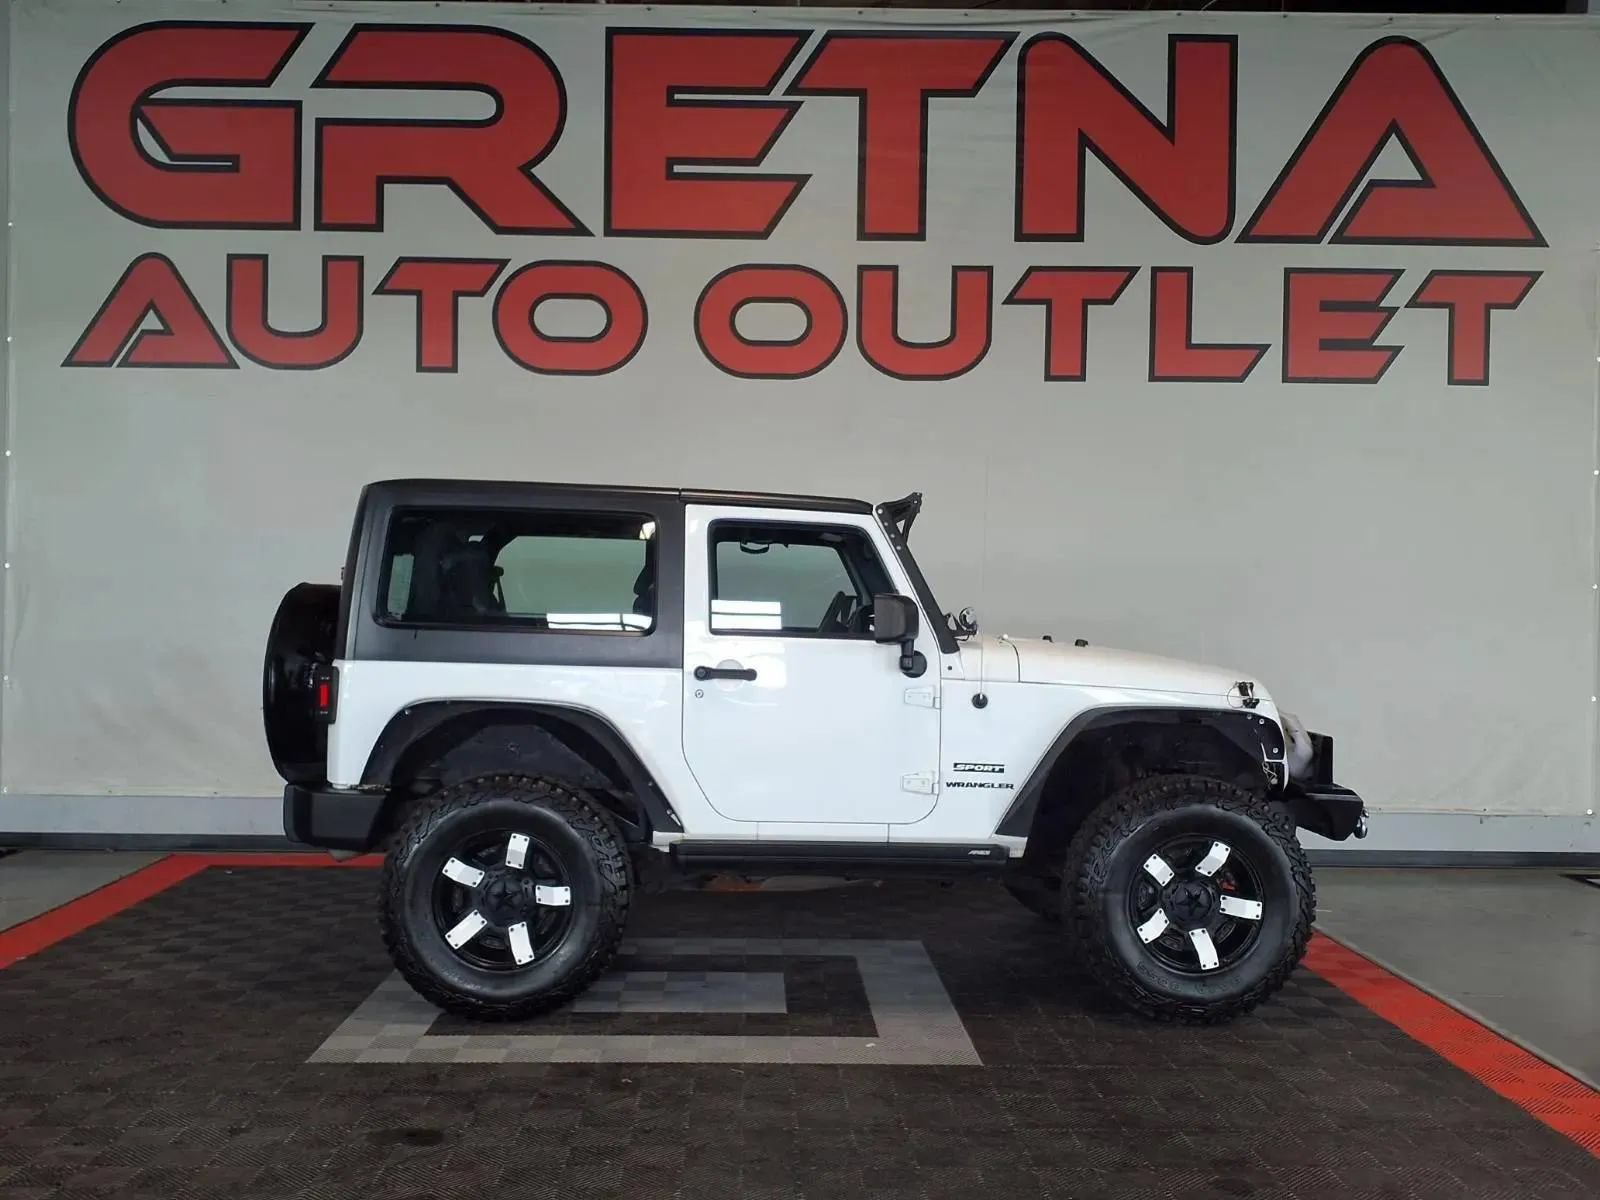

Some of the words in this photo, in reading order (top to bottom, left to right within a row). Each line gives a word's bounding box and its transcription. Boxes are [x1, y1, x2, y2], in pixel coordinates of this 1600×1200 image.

[67, 20, 1549, 248] GRETNA
[61, 252, 648, 376] AUTO
[694, 264, 1544, 386] OUTLET
[946, 782, 1014, 790] WRANGLER
[953, 763, 1004, 773] SPORT
